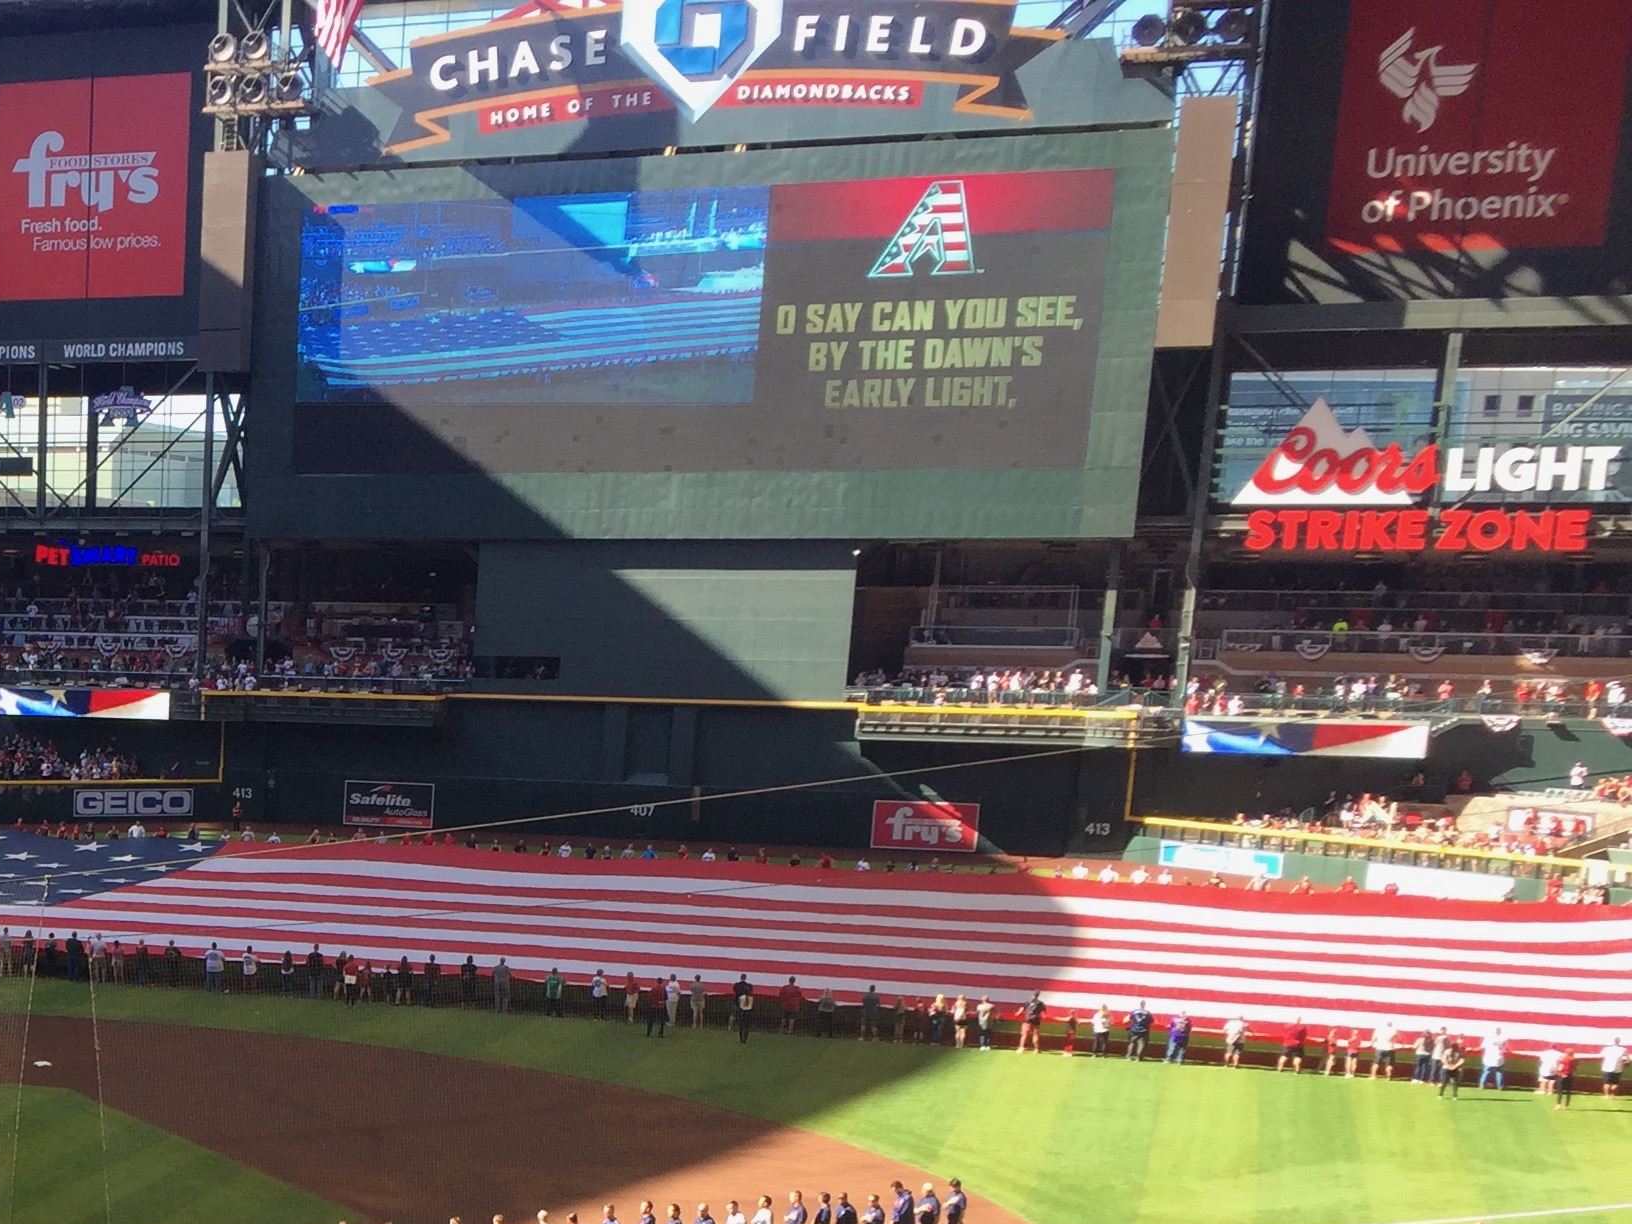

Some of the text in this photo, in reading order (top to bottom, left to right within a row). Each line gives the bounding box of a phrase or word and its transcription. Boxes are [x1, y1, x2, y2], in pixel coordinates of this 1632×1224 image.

[429, 14, 989, 93] CHASE FIELD
[489, 81, 911, 126] HOME OF THE DIAMONDBACKS
[12, 131, 160, 212] fry's
[49, 153, 150, 169] FOOD STORES
[1367, 141, 1557, 182] University
[21, 215, 103, 233] Fresh food.
[1360, 190, 1404, 224] of
[32, 232, 162, 252] Famous low prices.
[805, 302, 864, 334] SAY
[871, 300, 935, 332] CAN
[944, 297, 1008, 330] YOU
[1016, 294, 1084, 331] SEE,
[63, 341, 185, 358] WORLD CHAMPIONS
[808, 335, 1044, 372] BY THE DAWN'S
[824, 374, 1018, 409] EARLY LIGHT,
[1252, 426, 1622, 496] Coors LIGHT
[1244, 509, 1593, 552] STRIKE ZONE
[141, 552, 181, 567] PATIO
[76, 790, 191, 815] GEICO
[232, 786, 253, 799] 413
[349, 792, 413, 807] Safelite
[382, 806, 429, 818] AutoGlass
[885, 806, 964, 845] fry's
[1084, 822, 1112, 836] 413
